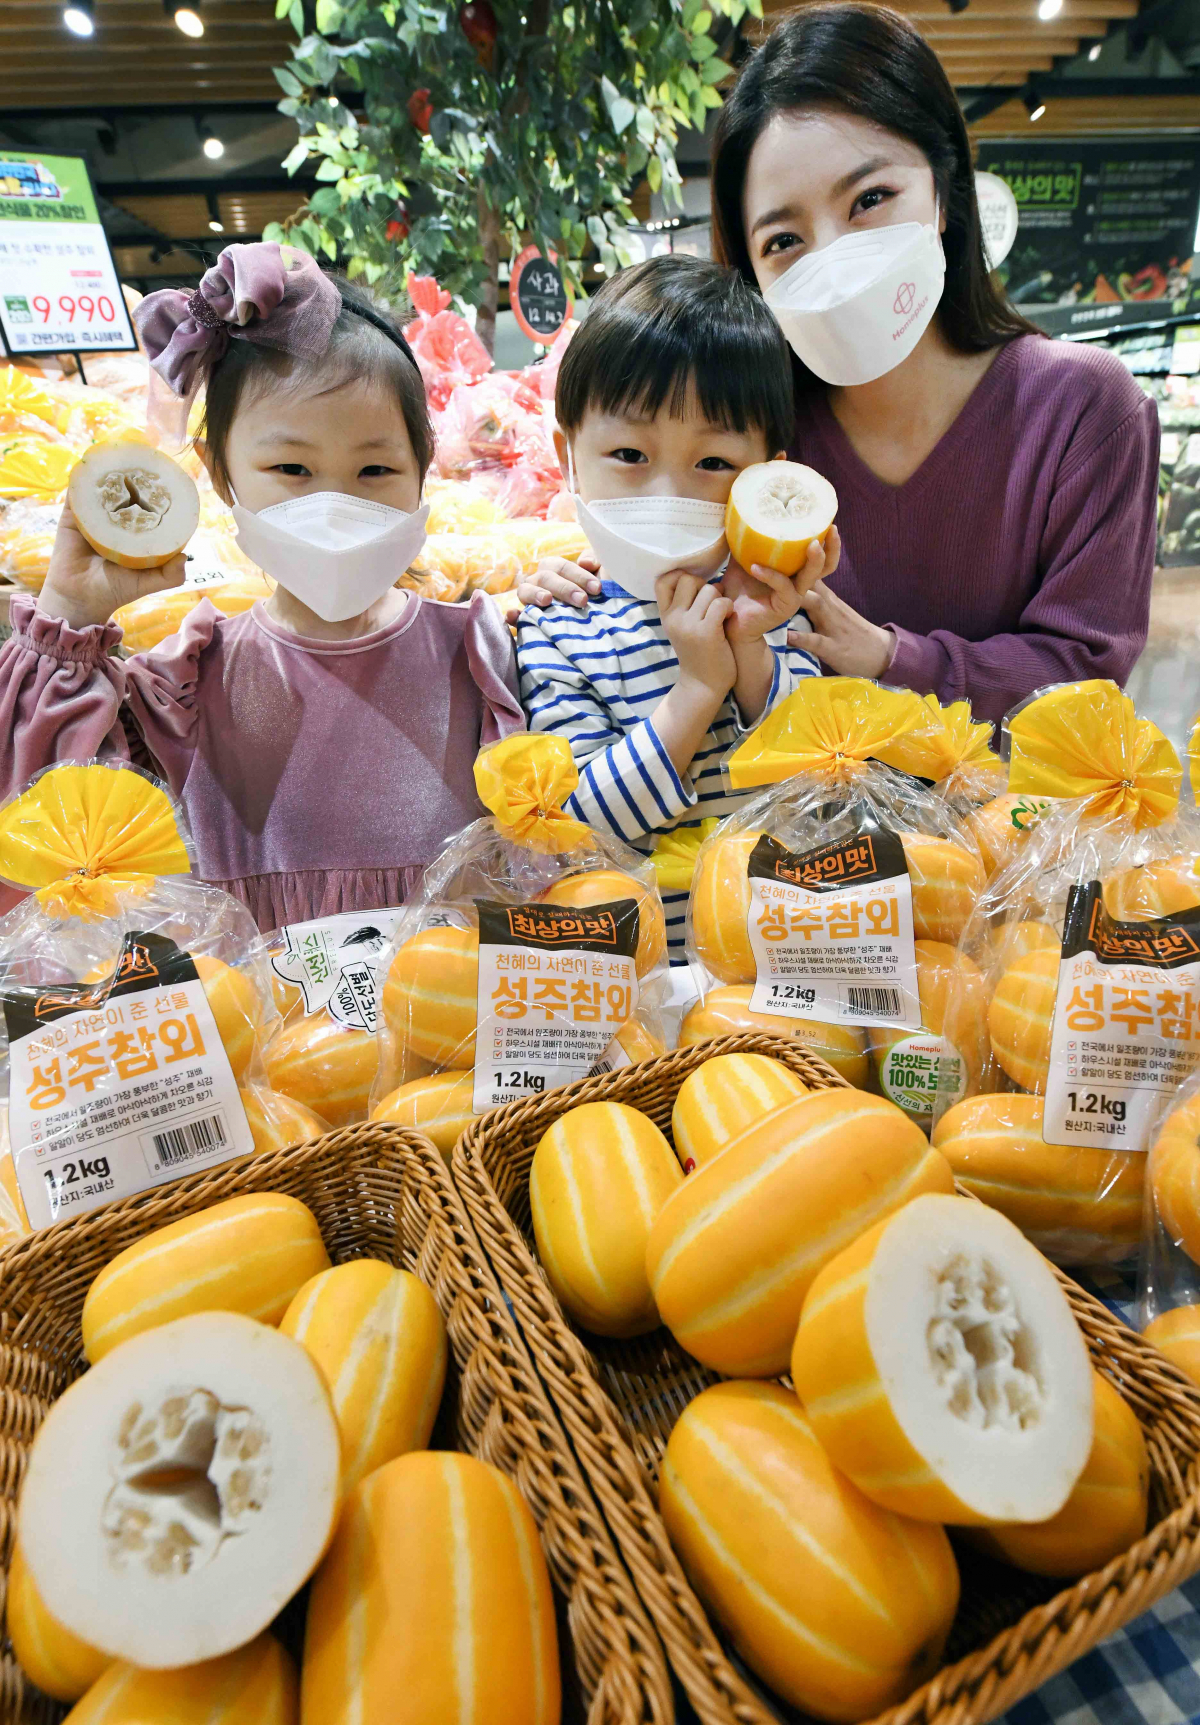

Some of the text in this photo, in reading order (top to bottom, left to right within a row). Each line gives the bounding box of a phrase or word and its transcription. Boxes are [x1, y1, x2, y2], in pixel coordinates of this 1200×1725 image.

[892, 296, 929, 341] Homeplus
[760, 884, 799, 903] 천혜의
[869, 884, 896, 896] 선물
[757, 897, 900, 941] 성주참외
[496, 953, 630, 981] 천혜의 자연이 준 선물
[1118, 969, 1172, 984] 자연이
[1176, 972, 1196, 986] 준
[337, 987, 357, 1017] 100%
[491, 976, 632, 1024] 성주참외
[771, 984, 816, 1003] 1.2kg
[73, 1006, 125, 1038] 자연이
[130, 1001, 149, 1021] 준
[154, 991, 190, 1015] 선물
[1066, 983, 1200, 1040] 성주참
[505, 1038, 540, 1048] 하우스시설
[506, 1028, 534, 1037] 전국에서
[565, 1029, 578, 1038] 가장
[527, 1051, 542, 1059] 당도
[571, 1053, 586, 1061] 더욱
[909, 1044, 941, 1053] Homeplu
[1081, 1041, 1114, 1053] 전국에서
[1116, 1044, 1148, 1056] 일조량이
[1150, 1046, 1167, 1058] 가장
[26, 1013, 207, 1111] 성주참외
[891, 1053, 932, 1070] 맛있는
[1081, 1054, 1121, 1067] 하우스시설
[1123, 1057, 1147, 1069] 재배로
[494, 1071, 546, 1093] 1.2kg
[889, 1068, 926, 1089] 100%
[1107, 1069, 1122, 1080] 당도
[1124, 1071, 1158, 1082] 엄선하여
[45, 1109, 78, 1127] 전국에서
[79, 1096, 112, 1116] 일조량이
[113, 1090, 131, 1103] 가장
[132, 1081, 159, 1097] 풍부한
[186, 1067, 203, 1079] 재배
[90, 1108, 117, 1124] 재배로
[117, 1092, 169, 1115] 아삭아삭하게
[171, 1082, 195, 1098] 차오른
[197, 1076, 214, 1088] 식감
[1067, 1092, 1127, 1122] 1.2kg
[76, 1129, 95, 1143] 당도
[95, 1118, 131, 1137] 엄선하여
[131, 1110, 150, 1123] 더욱
[150, 1101, 176, 1118] 달콤한
[177, 1095, 195, 1109] 맛과
[196, 1089, 214, 1102] 향기
[1065, 1119, 1127, 1136] 원산지:국내산
[154, 1141, 226, 1171] 8 809045 540074
[43, 1156, 111, 1189] 1.2kg
